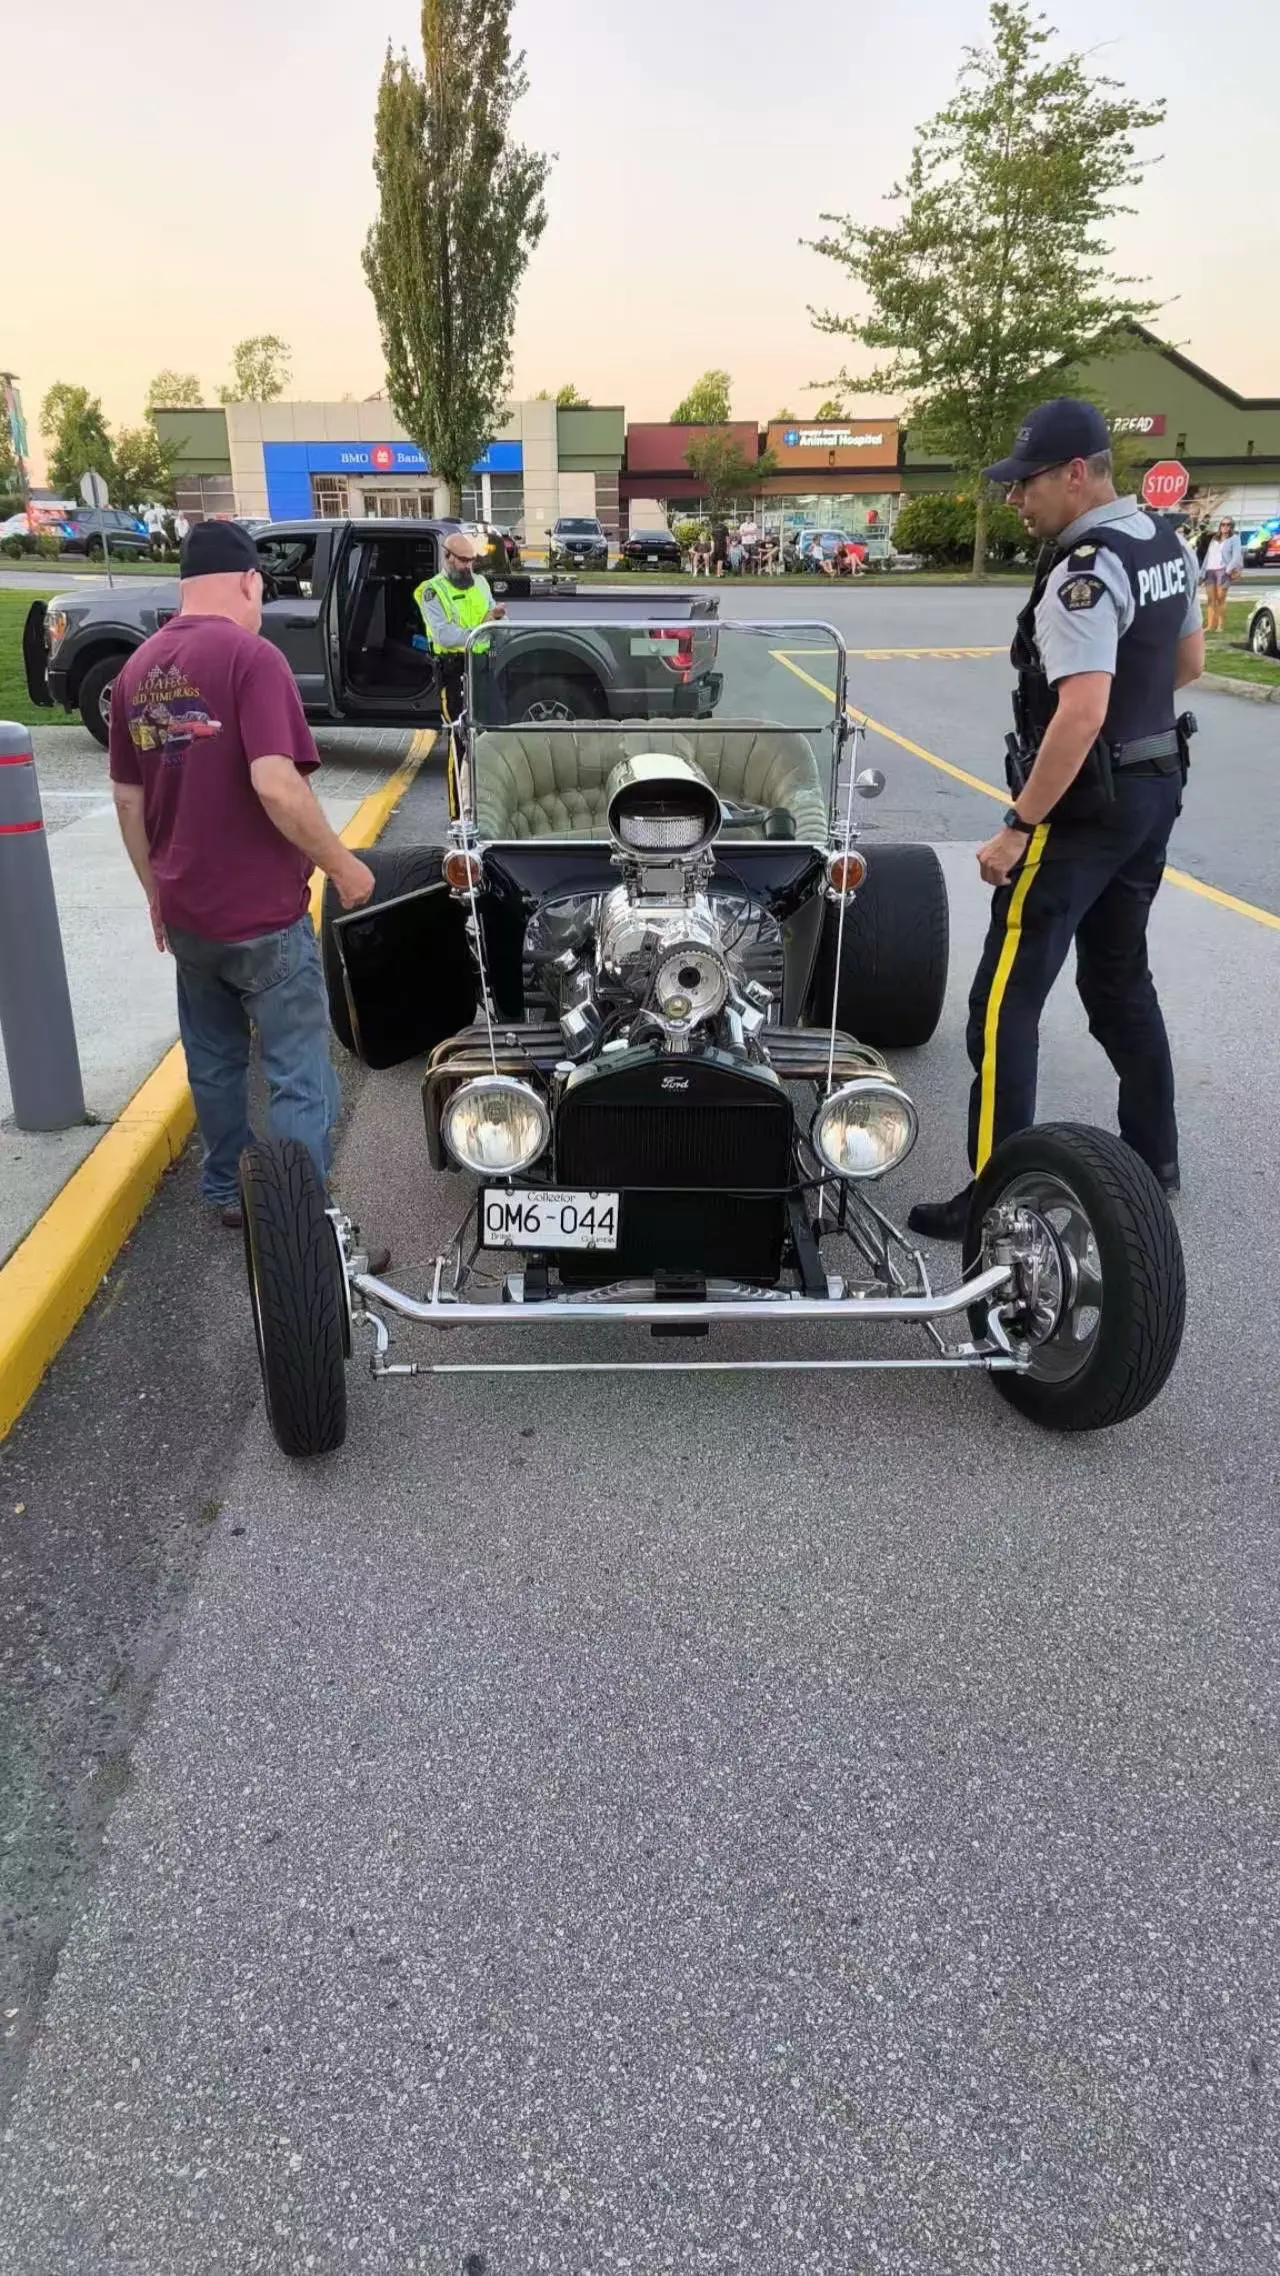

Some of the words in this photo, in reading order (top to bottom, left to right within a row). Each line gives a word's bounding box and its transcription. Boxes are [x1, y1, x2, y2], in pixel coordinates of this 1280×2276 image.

[799, 434, 837, 446] Animal
[838, 432, 882, 447] Hospital
[341, 453, 369, 463] BMO
[397, 453, 425, 464] Bank
[1147, 475, 1184, 493] STOP
[1137, 558, 1185, 606] POLICE
[661, 1076, 689, 1089] Ford
[527, 1191, 577, 1203] Collector
